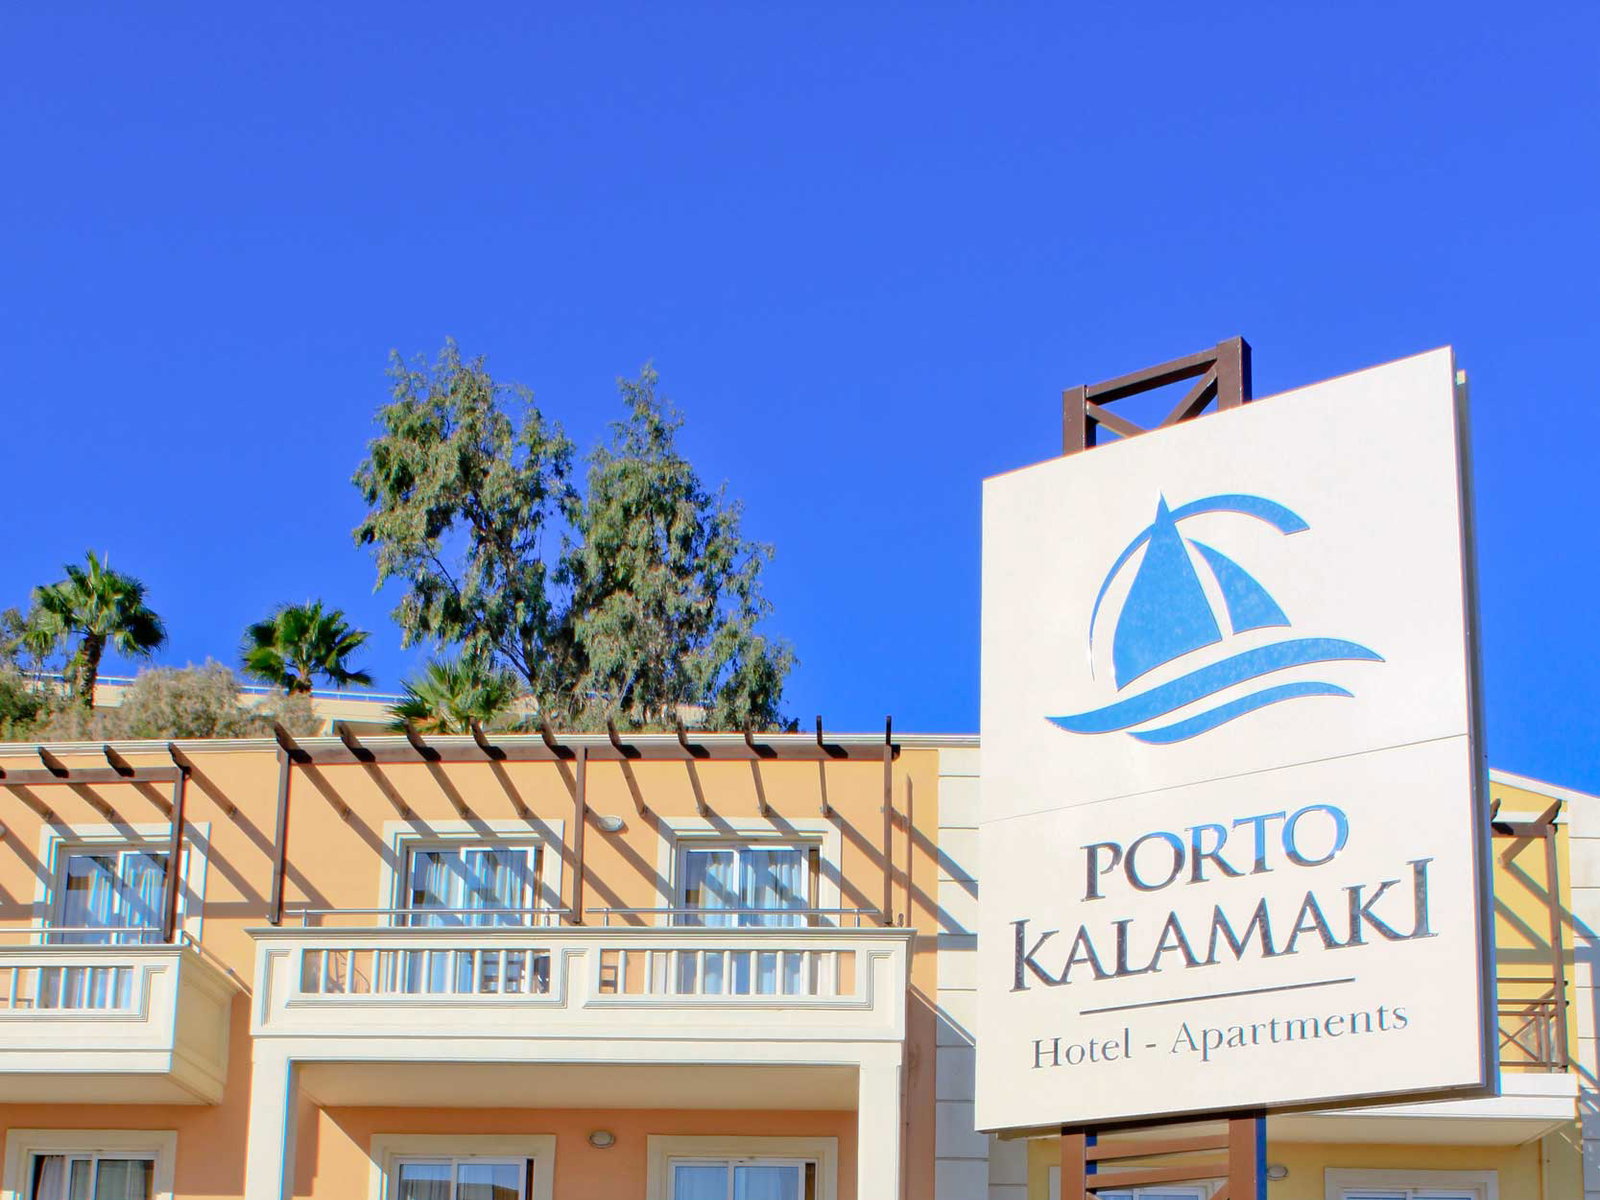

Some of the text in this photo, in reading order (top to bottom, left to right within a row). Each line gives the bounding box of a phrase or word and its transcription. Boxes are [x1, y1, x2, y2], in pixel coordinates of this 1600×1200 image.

[1080, 804, 1349, 902] PORTO
[1009, 858, 1439, 992] KALAMAKI
[1031, 1028, 1131, 1069] Hotel
[1169, 1004, 1408, 1062] Apartments
